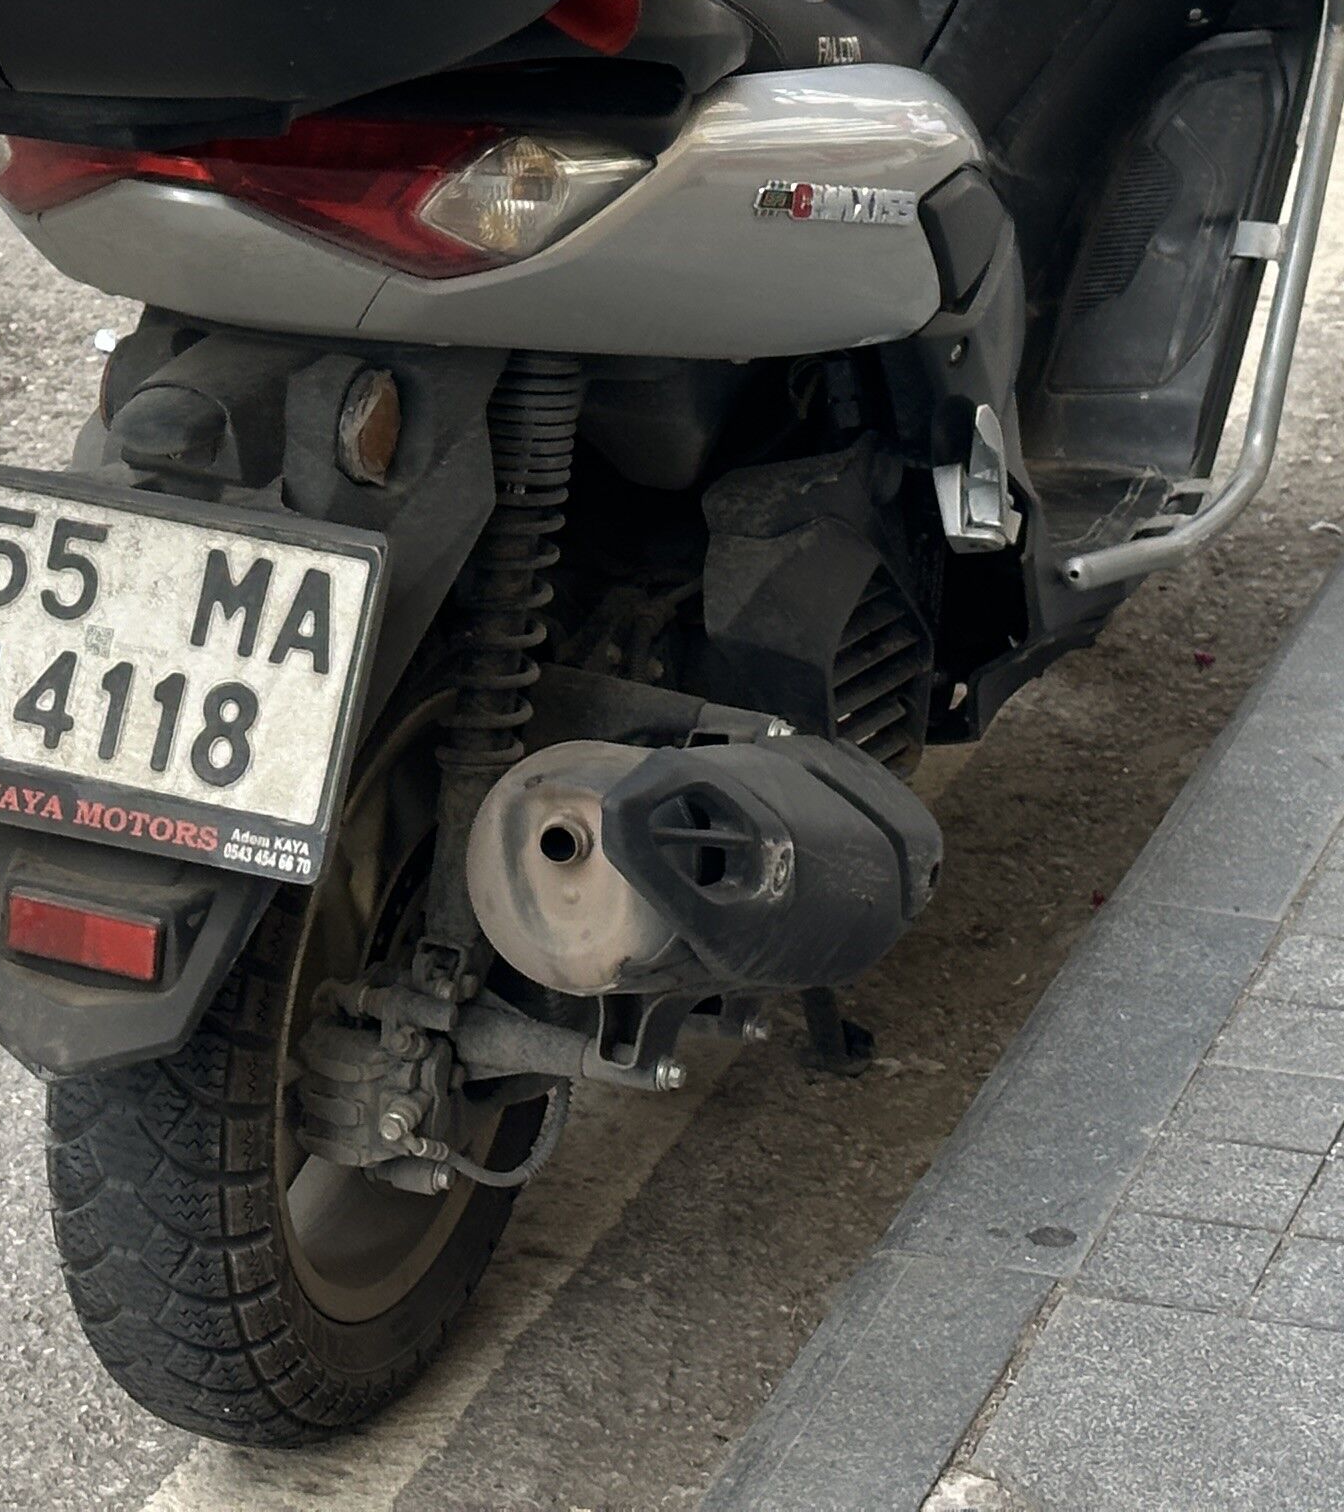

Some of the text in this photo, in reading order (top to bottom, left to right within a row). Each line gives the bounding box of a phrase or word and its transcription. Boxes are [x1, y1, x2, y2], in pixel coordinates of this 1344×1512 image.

[189, 548, 333, 676] MA
[12, 650, 260, 788] 4118
[74, 798, 219, 852] MOTORS
[231, 828, 311, 856] Adem KAYA
[223, 843, 252, 862] 0543
[256, 850, 277, 867] 454
[296, 858, 311, 874] 70
